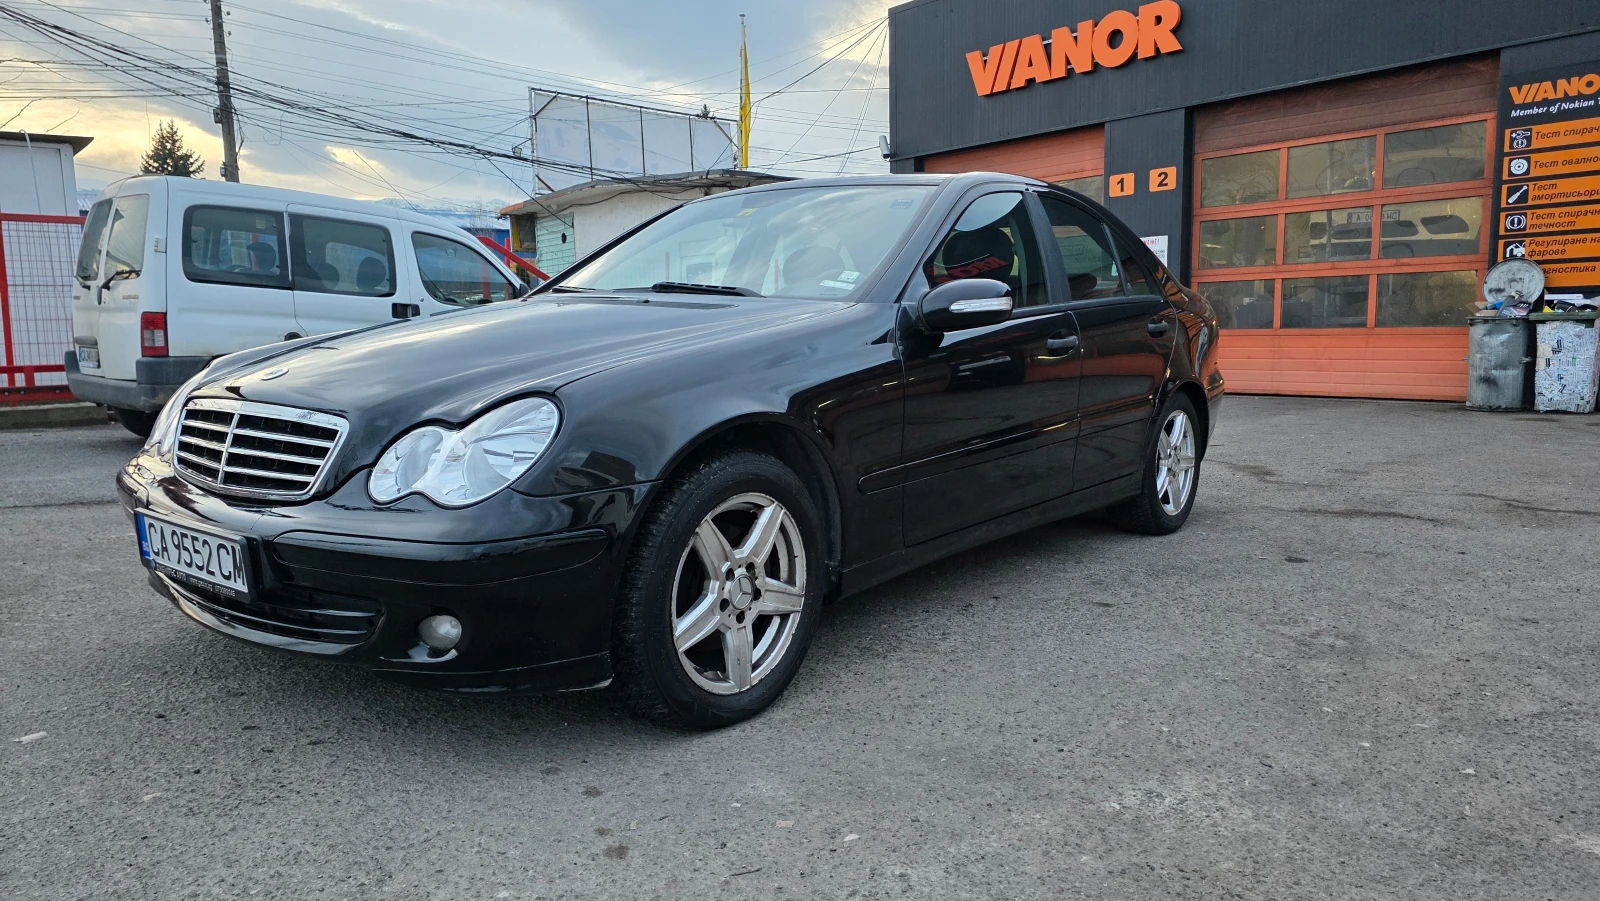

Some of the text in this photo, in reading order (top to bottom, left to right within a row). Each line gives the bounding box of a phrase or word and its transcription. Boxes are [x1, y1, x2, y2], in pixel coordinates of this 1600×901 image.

[965, 0, 1183, 97] VIANOR
[1510, 106, 1548, 117] Member
[1549, 102, 1561, 113] of
[1561, 99, 1595, 111] Nokian
[1535, 125, 1600, 140] Тест спирач
[1533, 155, 1600, 169] Тест овално
[1116, 177, 1125, 193] 1
[1157, 171, 1169, 188] 2
[1532, 183, 1557, 192] Тест
[1530, 212, 1556, 220] Тест
[1528, 220, 1576, 231] течност
[1528, 237, 1588, 248] Регулиране
[1528, 248, 1567, 259] фарове
[1542, 265, 1596, 275] агностика
[148, 522, 246, 587] CA 9552 CM
